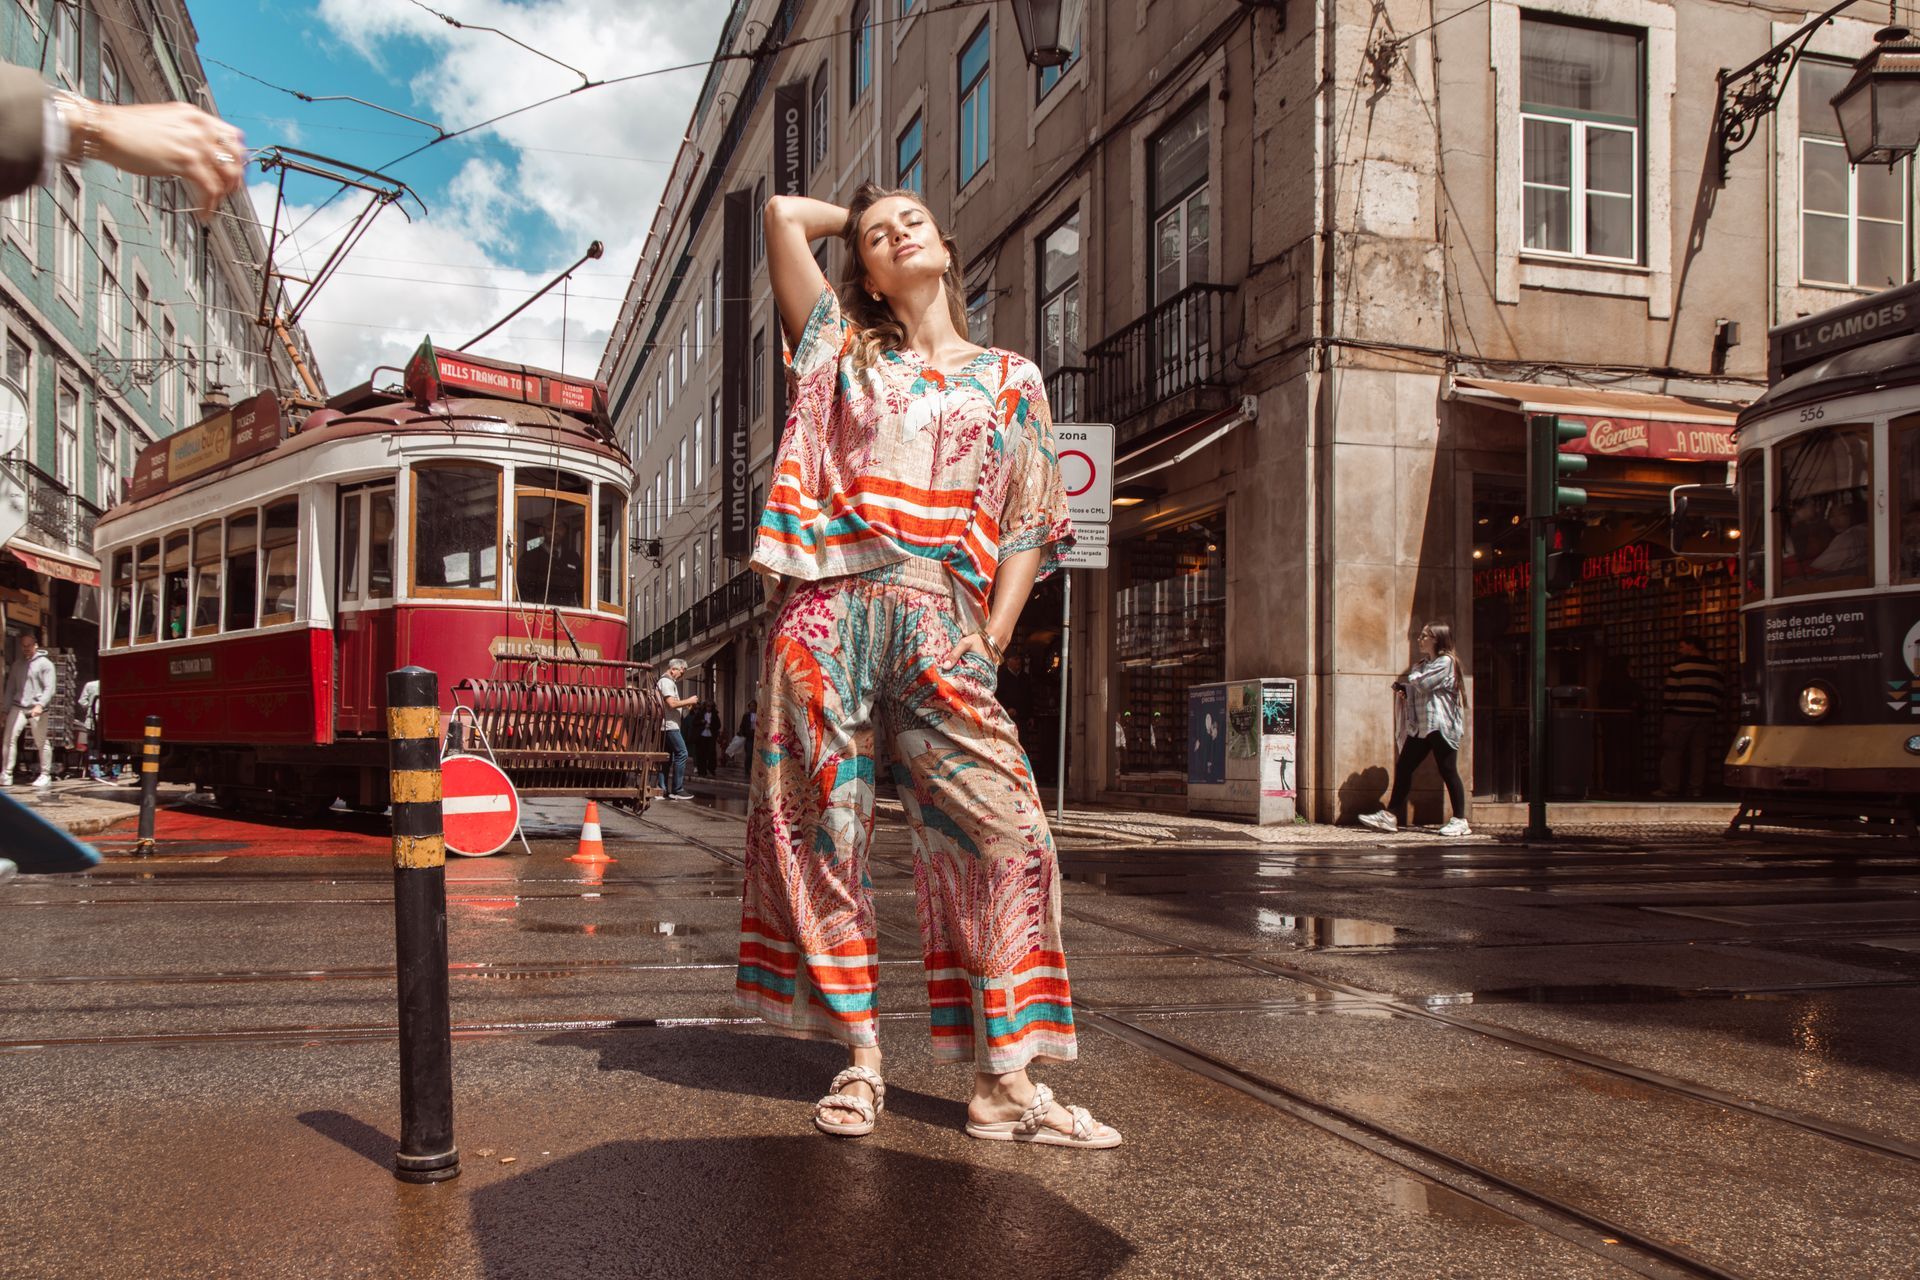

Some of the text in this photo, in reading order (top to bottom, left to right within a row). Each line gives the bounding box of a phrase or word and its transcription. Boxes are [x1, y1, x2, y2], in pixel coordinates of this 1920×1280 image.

[785, 108, 799, 196] M-VINDO
[441, 362, 468, 380] HILLS
[511, 378, 533, 393] TOR
[562, 390, 585, 401] PREMIUM
[1800, 406, 1824, 422] 556
[1059, 431, 1087, 441] zona
[1590, 420, 1648, 453] Comur
[1766, 611, 1864, 630] Sabe de onde vem
[1766, 625, 1836, 641] este elétrico?
